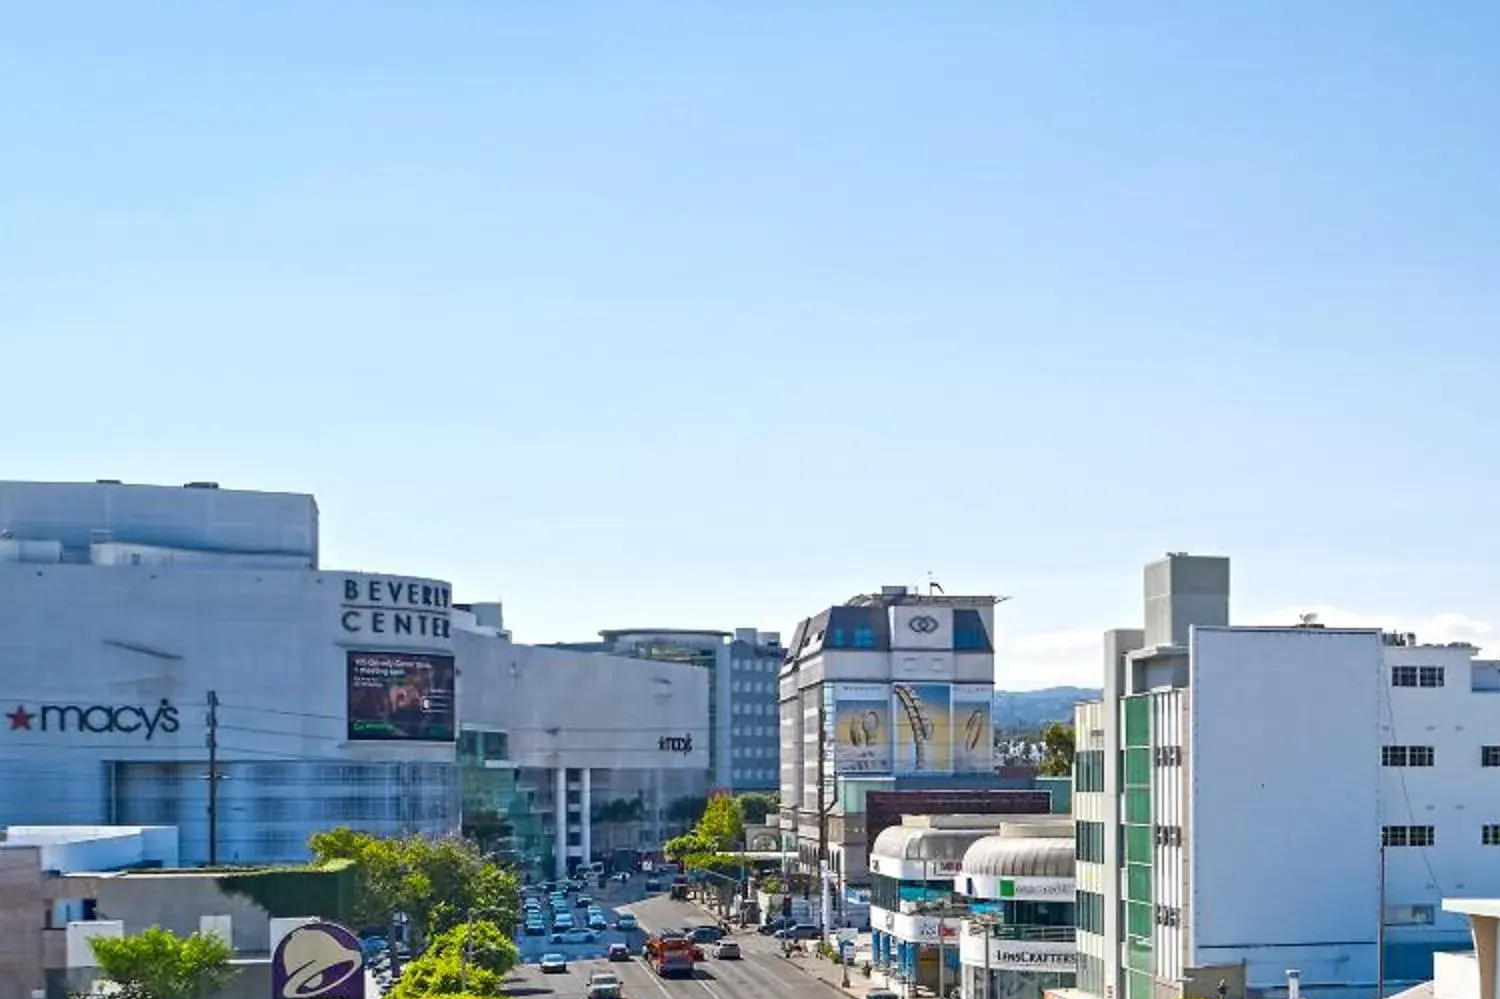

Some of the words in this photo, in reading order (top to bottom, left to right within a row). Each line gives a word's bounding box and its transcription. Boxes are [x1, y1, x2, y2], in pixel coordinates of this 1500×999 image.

[344, 579, 449, 608] BEVERLY
[341, 610, 450, 638] CENTER
[40, 698, 180, 741] macy's
